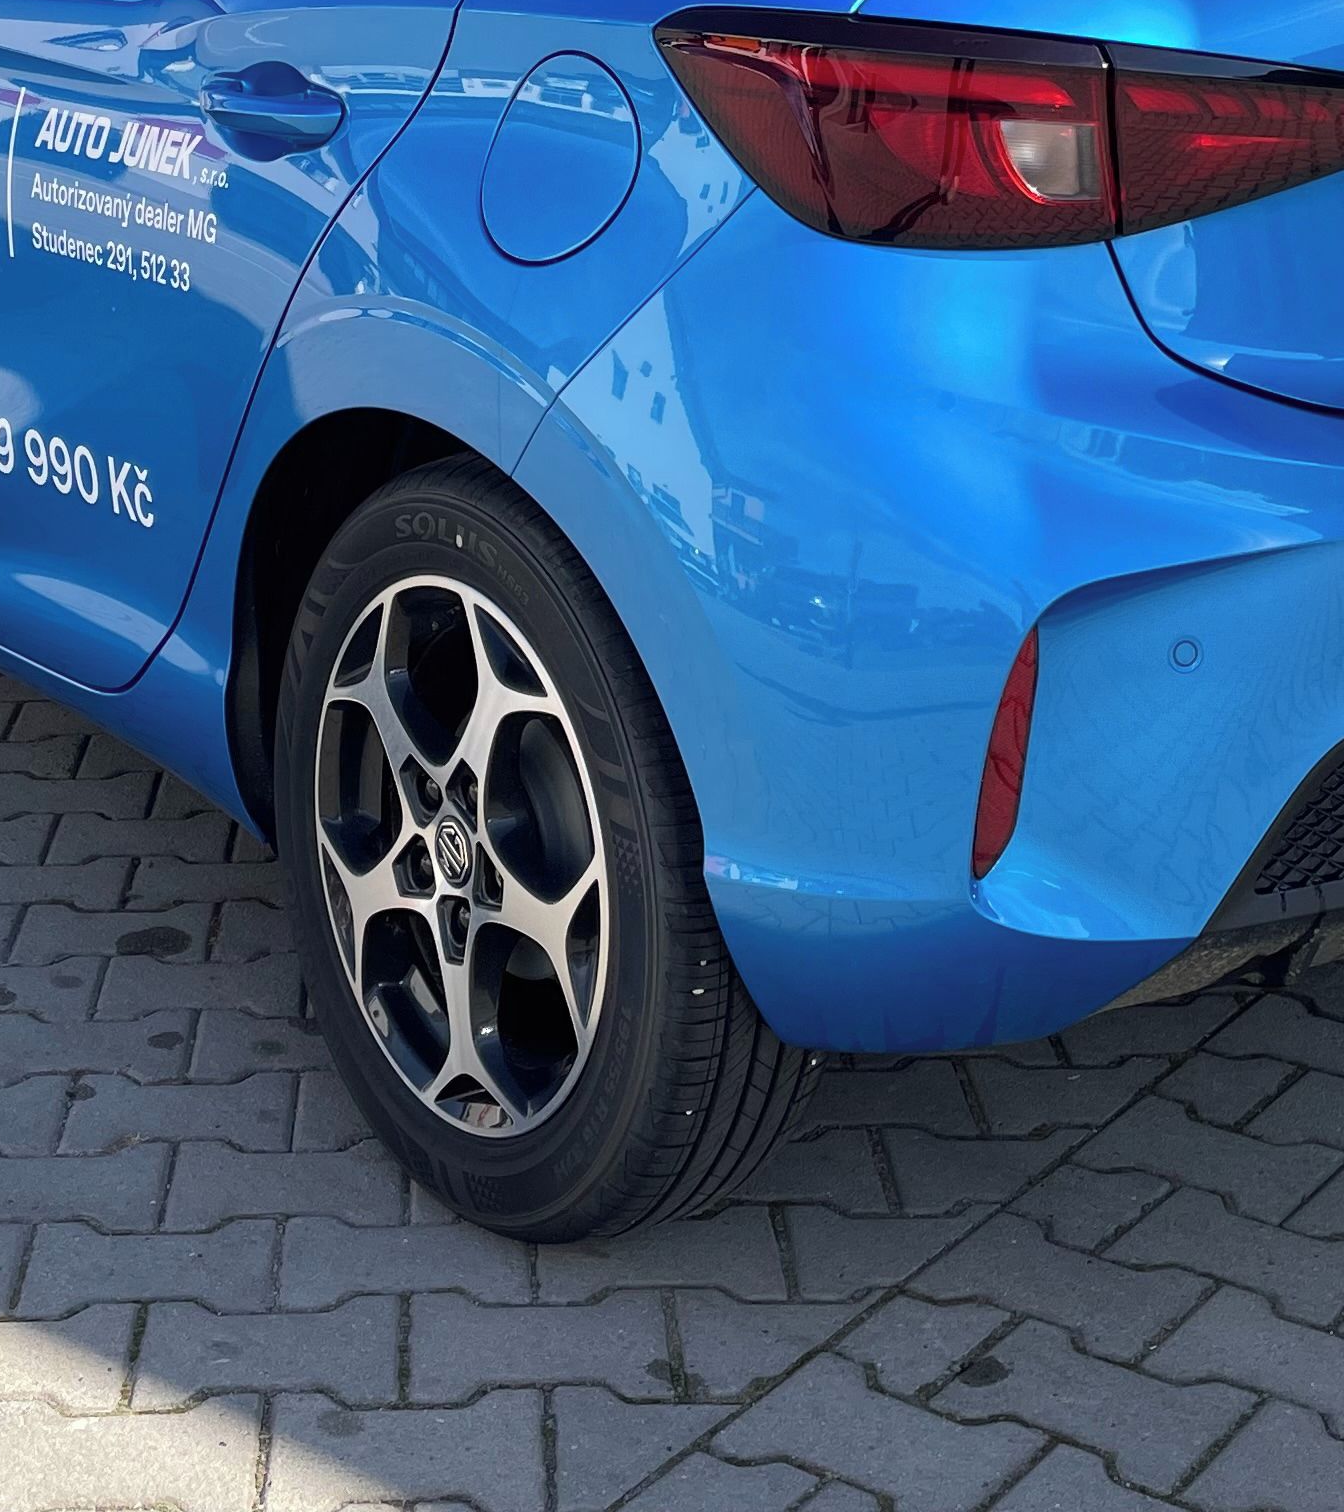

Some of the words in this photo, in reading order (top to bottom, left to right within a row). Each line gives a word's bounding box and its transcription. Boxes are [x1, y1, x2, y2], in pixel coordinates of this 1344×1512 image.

[34, 107, 112, 160] AUTO
[31, 172, 132, 228] Autorizovaný
[135, 197, 184, 235] dealer
[186, 208, 217, 244] MG
[32, 222, 103, 266] Studenec
[106, 241, 137, 281] 291,
[141, 251, 166, 285] 512
[170, 258, 190, 292] 33
[24, 427, 98, 506] 990
[109, 455, 155, 528] Kč
